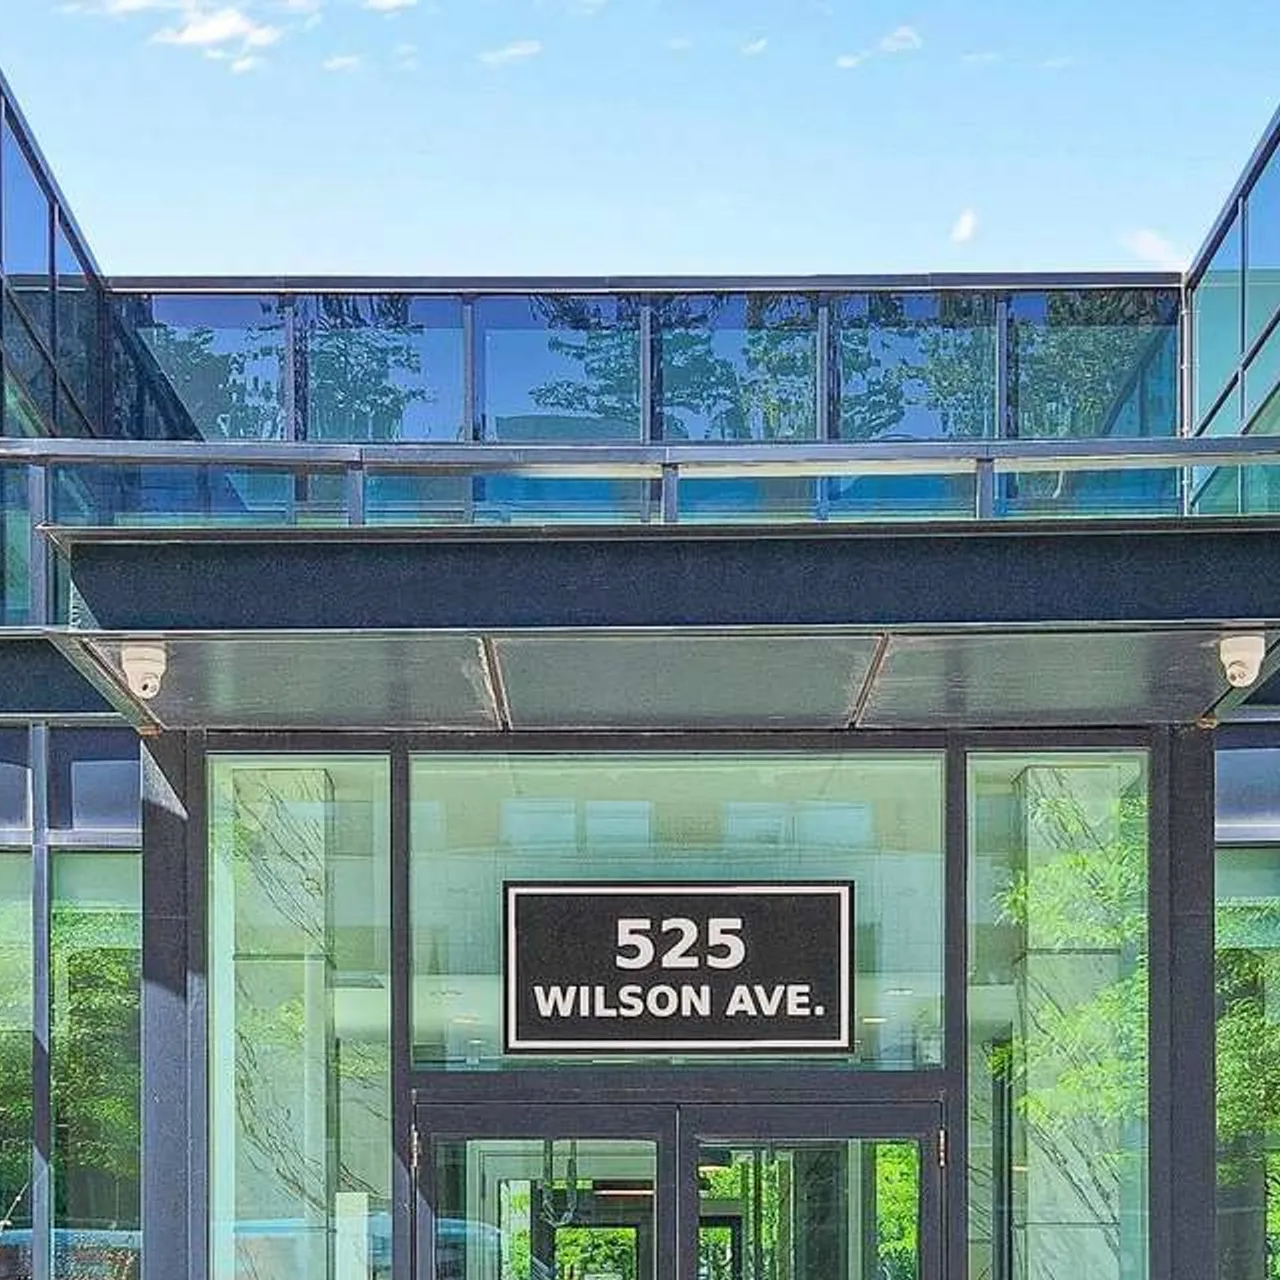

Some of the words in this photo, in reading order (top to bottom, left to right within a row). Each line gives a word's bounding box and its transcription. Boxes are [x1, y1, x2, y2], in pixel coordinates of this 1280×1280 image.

[615, 917, 746, 970] 525
[533, 985, 711, 1018] WILSON
[726, 985, 825, 1017] AVE.
